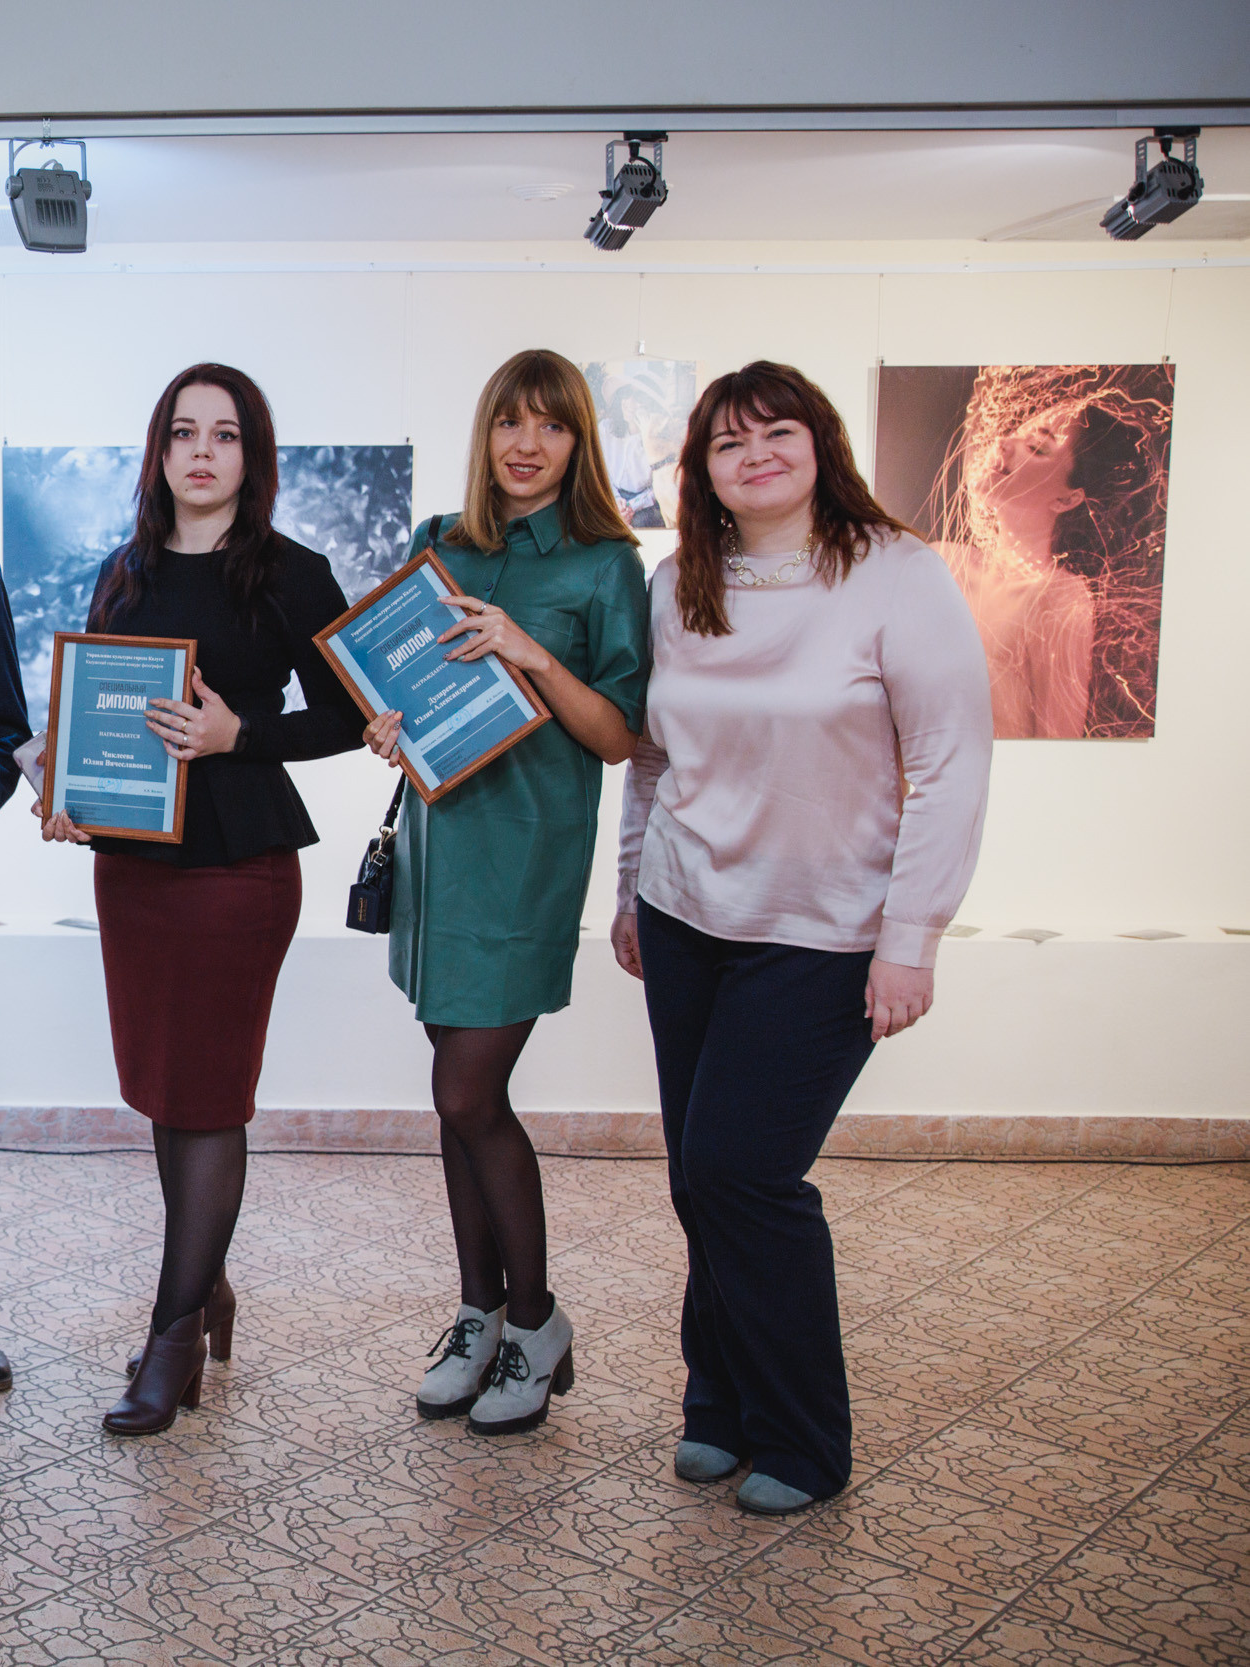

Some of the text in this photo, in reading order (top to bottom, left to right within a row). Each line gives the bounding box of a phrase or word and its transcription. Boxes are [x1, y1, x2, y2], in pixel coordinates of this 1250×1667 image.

[380, 618, 423, 654] СПЕЦИАЛЬНЫЙ
[386, 626, 435, 671] ДИПЛОМ
[411, 661, 449, 691] НАГРАЖДАЕТСЯ
[99, 682, 146, 693] СПЕЦИАЛЬНЫЙ
[428, 682, 457, 706] Дударева
[96, 693, 147, 710] ДИПЛОМ
[414, 709, 434, 726] Юлия
[434, 675, 481, 711] Александровна
[99, 731, 140, 739] НАГРАЖДАЕТСЯ
[102, 751, 134, 759] Чиклеева
[105, 760, 152, 770] Вячеславовна
